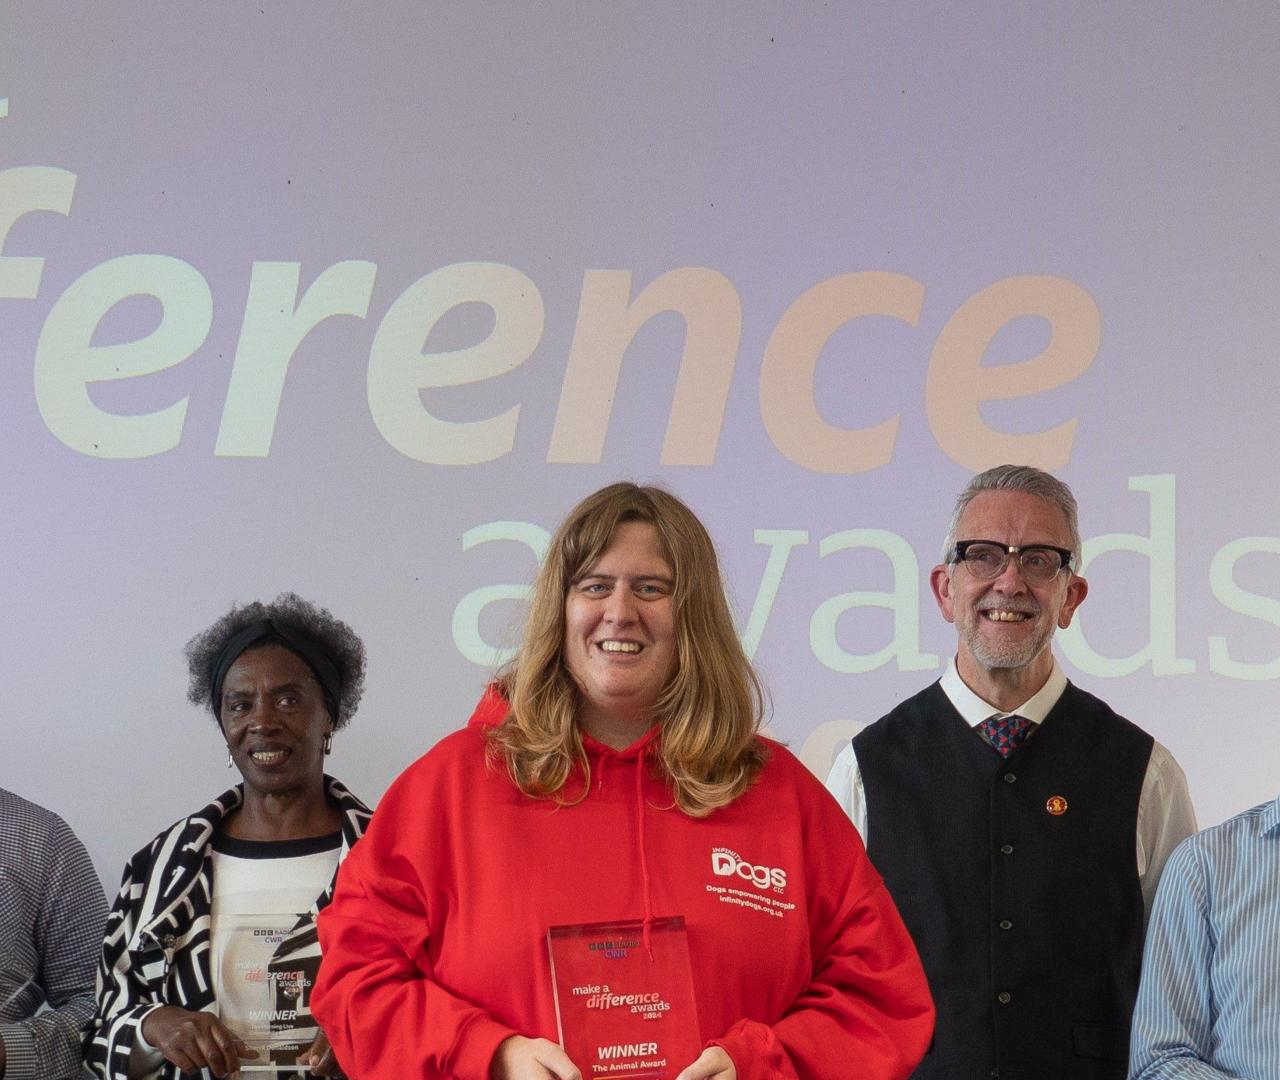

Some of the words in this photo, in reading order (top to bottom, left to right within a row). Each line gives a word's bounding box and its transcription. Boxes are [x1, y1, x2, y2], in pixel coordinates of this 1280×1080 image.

[711, 852, 787, 889] Dogs
[706, 885, 727, 893] Dogs
[728, 888, 771, 905] empowering
[772, 899, 795, 910] people
[572, 984, 601, 995] make
[603, 985, 610, 993] a
[586, 993, 660, 1010] difference
[630, 1001, 671, 1013] awards
[249, 1010, 297, 1020] WINNER
[598, 1042, 658, 1060] WINNER
[592, 1064, 608, 1072] The
[609, 1061, 638, 1071] Animal
[640, 1059, 667, 1068] Award
